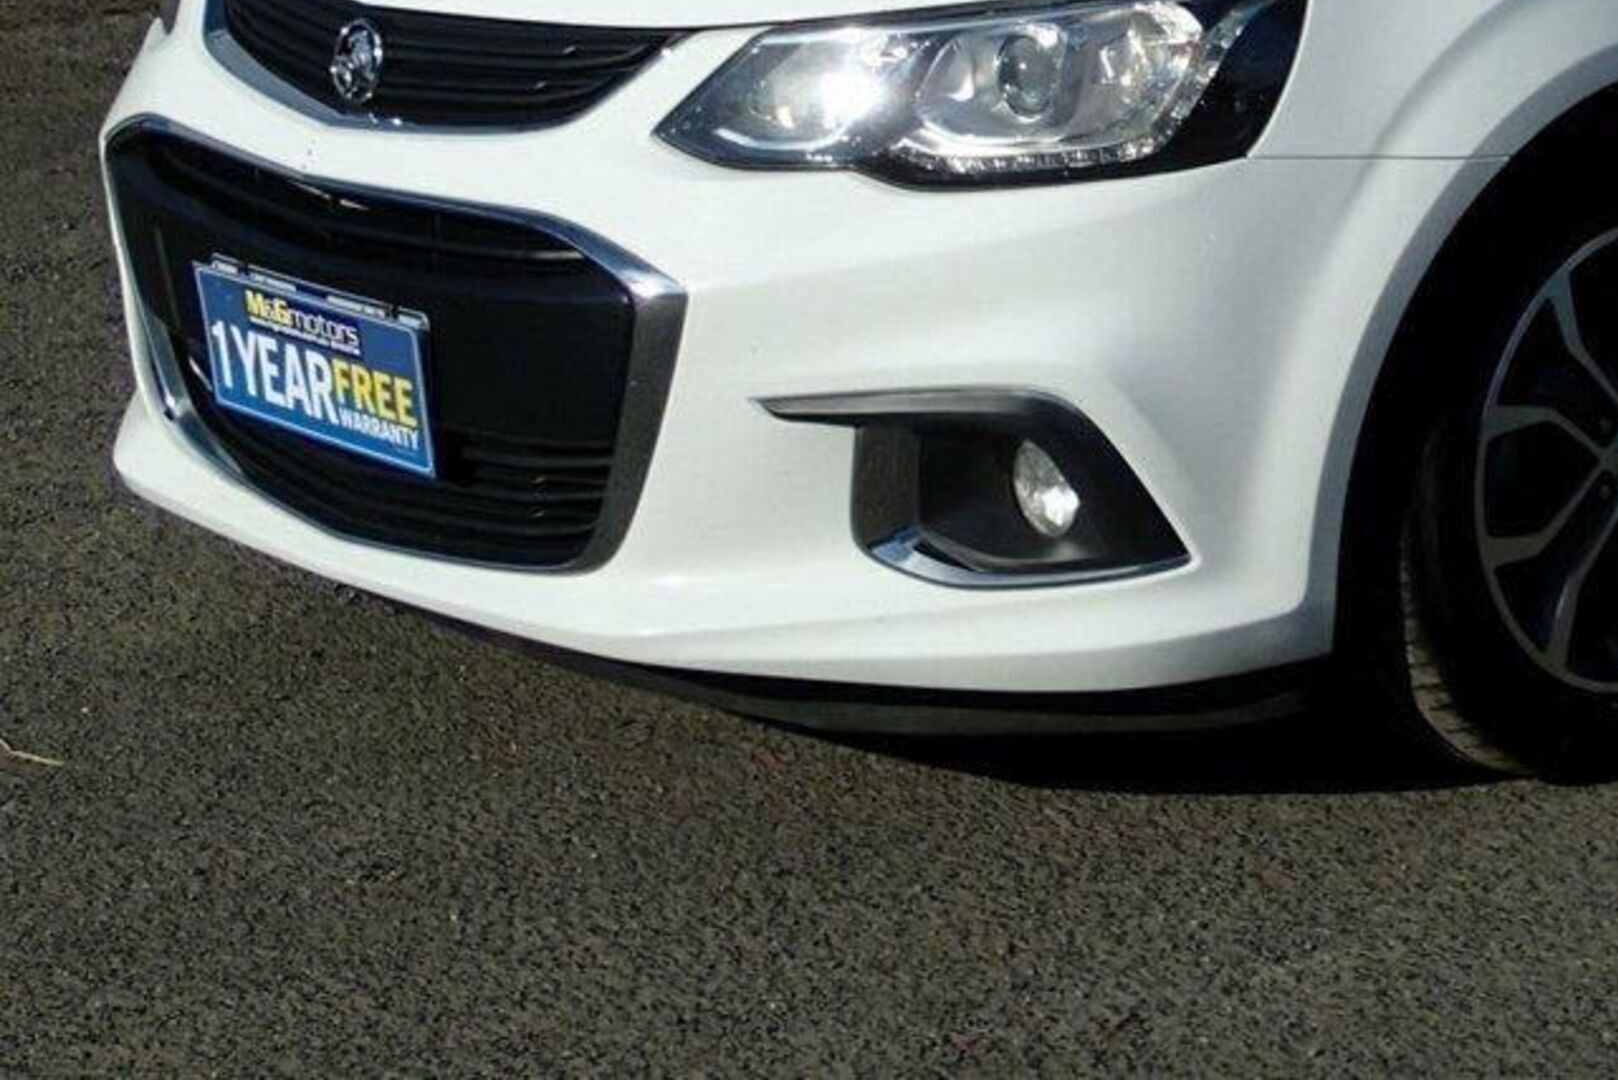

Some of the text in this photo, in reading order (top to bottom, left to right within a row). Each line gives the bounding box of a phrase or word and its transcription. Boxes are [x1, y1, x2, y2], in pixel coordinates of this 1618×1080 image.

[211, 320, 234, 389] 1
[229, 324, 340, 426] YEAR
[330, 357, 418, 428] FREE
[337, 406, 420, 451] WARRANTY
